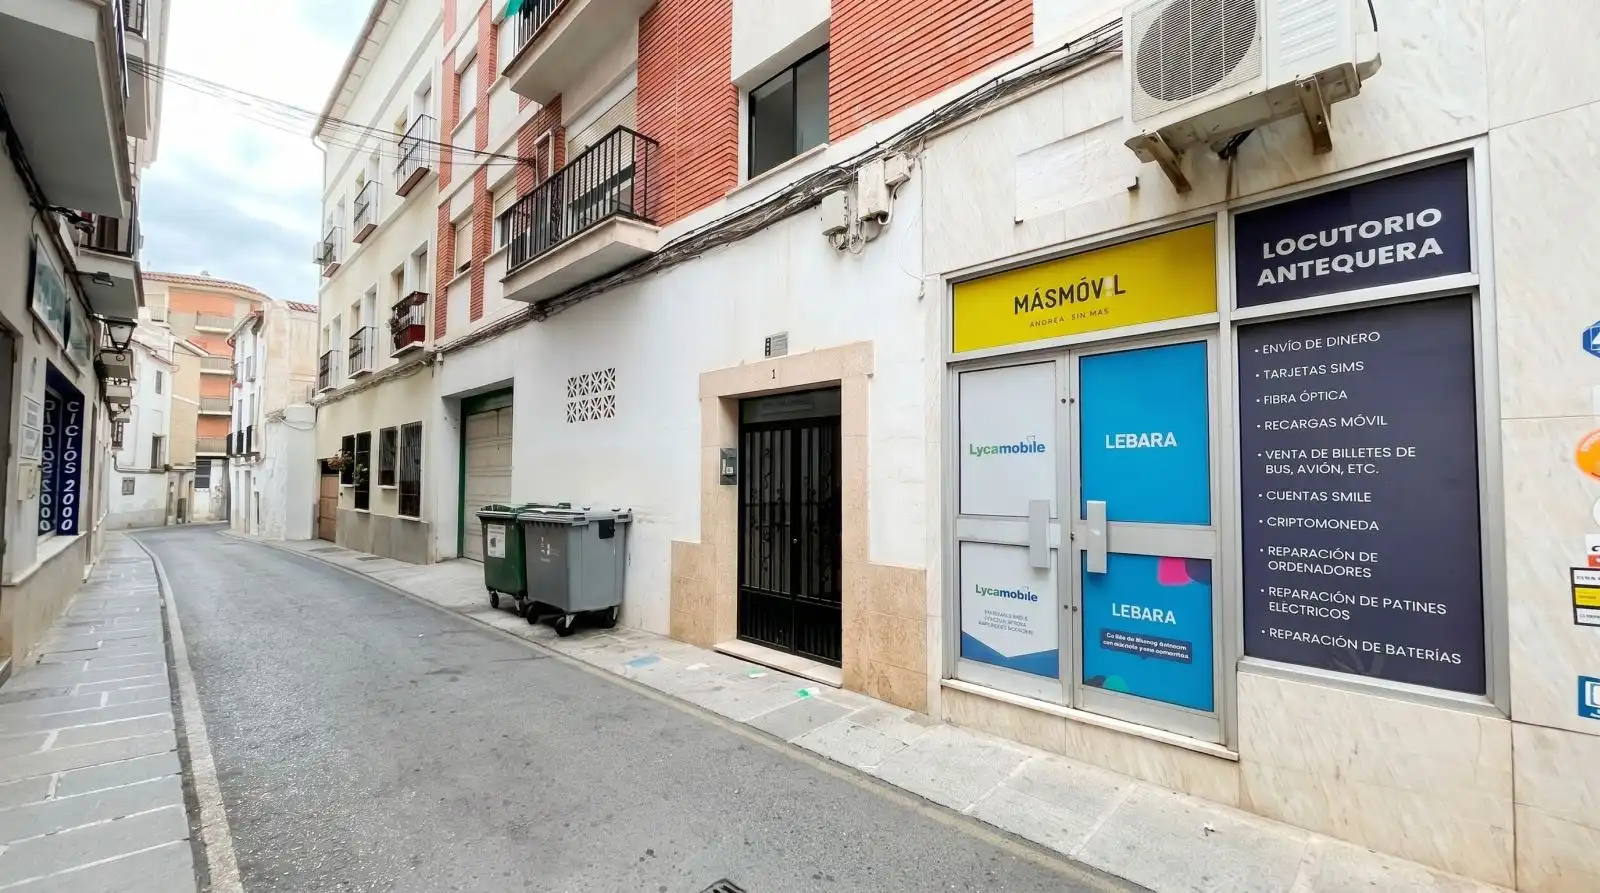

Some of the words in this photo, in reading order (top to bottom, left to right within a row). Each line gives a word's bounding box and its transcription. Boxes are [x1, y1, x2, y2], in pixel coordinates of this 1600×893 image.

[1263, 208, 1442, 259] LOCUTORIO
[1257, 237, 1443, 287] ANTEQUERA
[1014, 274, 1126, 315] MÁSMÓVL
[1071, 312, 1086, 320] SIN
[1262, 339, 1302, 355] ENVÍO
[1305, 338, 1322, 350] DE
[1326, 331, 1381, 348] DINERO
[771, 368, 776, 380] 1
[1264, 364, 1327, 380] TARJETAS
[1330, 361, 1364, 374] SIMS
[1264, 393, 1297, 405] FIBRA
[1299, 390, 1348, 403] ÓPTICA
[1264, 417, 1337, 431] RECARGAS
[1341, 414, 1388, 428] MÓVIL
[64, 401, 80, 474] CICLOS
[1105, 432, 1178, 449] LEBARA
[969, 440, 1046, 457] Lycamobile
[1265, 449, 1308, 460] VENTA
[1311, 448, 1329, 459] DE
[1332, 447, 1392, 459] BILLETES
[1396, 446, 1416, 457] DE
[1265, 464, 1294, 475] BUS,
[1297, 462, 1344, 475] AVIÓN,
[1348, 463, 1379, 474] ETC.
[61, 479, 76, 531] 2000
[1266, 490, 1328, 502] CUENTAS
[1331, 491, 1372, 503] SMILE
[1267, 516, 1380, 531] CRIPTOMONEDA
[1268, 545, 1355, 561] REPARACIÓN
[1359, 551, 1378, 563] DE
[1268, 561, 1372, 578] ORDENADORES
[975, 583, 1038, 602] Lycamobile
[1268, 586, 1355, 605] REPARACIÓN
[1359, 596, 1378, 608] DE
[1383, 598, 1447, 615] PATINES
[1111, 602, 1177, 625] LEBARA
[1269, 601, 1351, 621] ELÉCTRICOS
[1269, 627, 1358, 649] REPARACIÓN
[1362, 640, 1381, 653] DE
[1385, 643, 1462, 665] BATERÍAS
